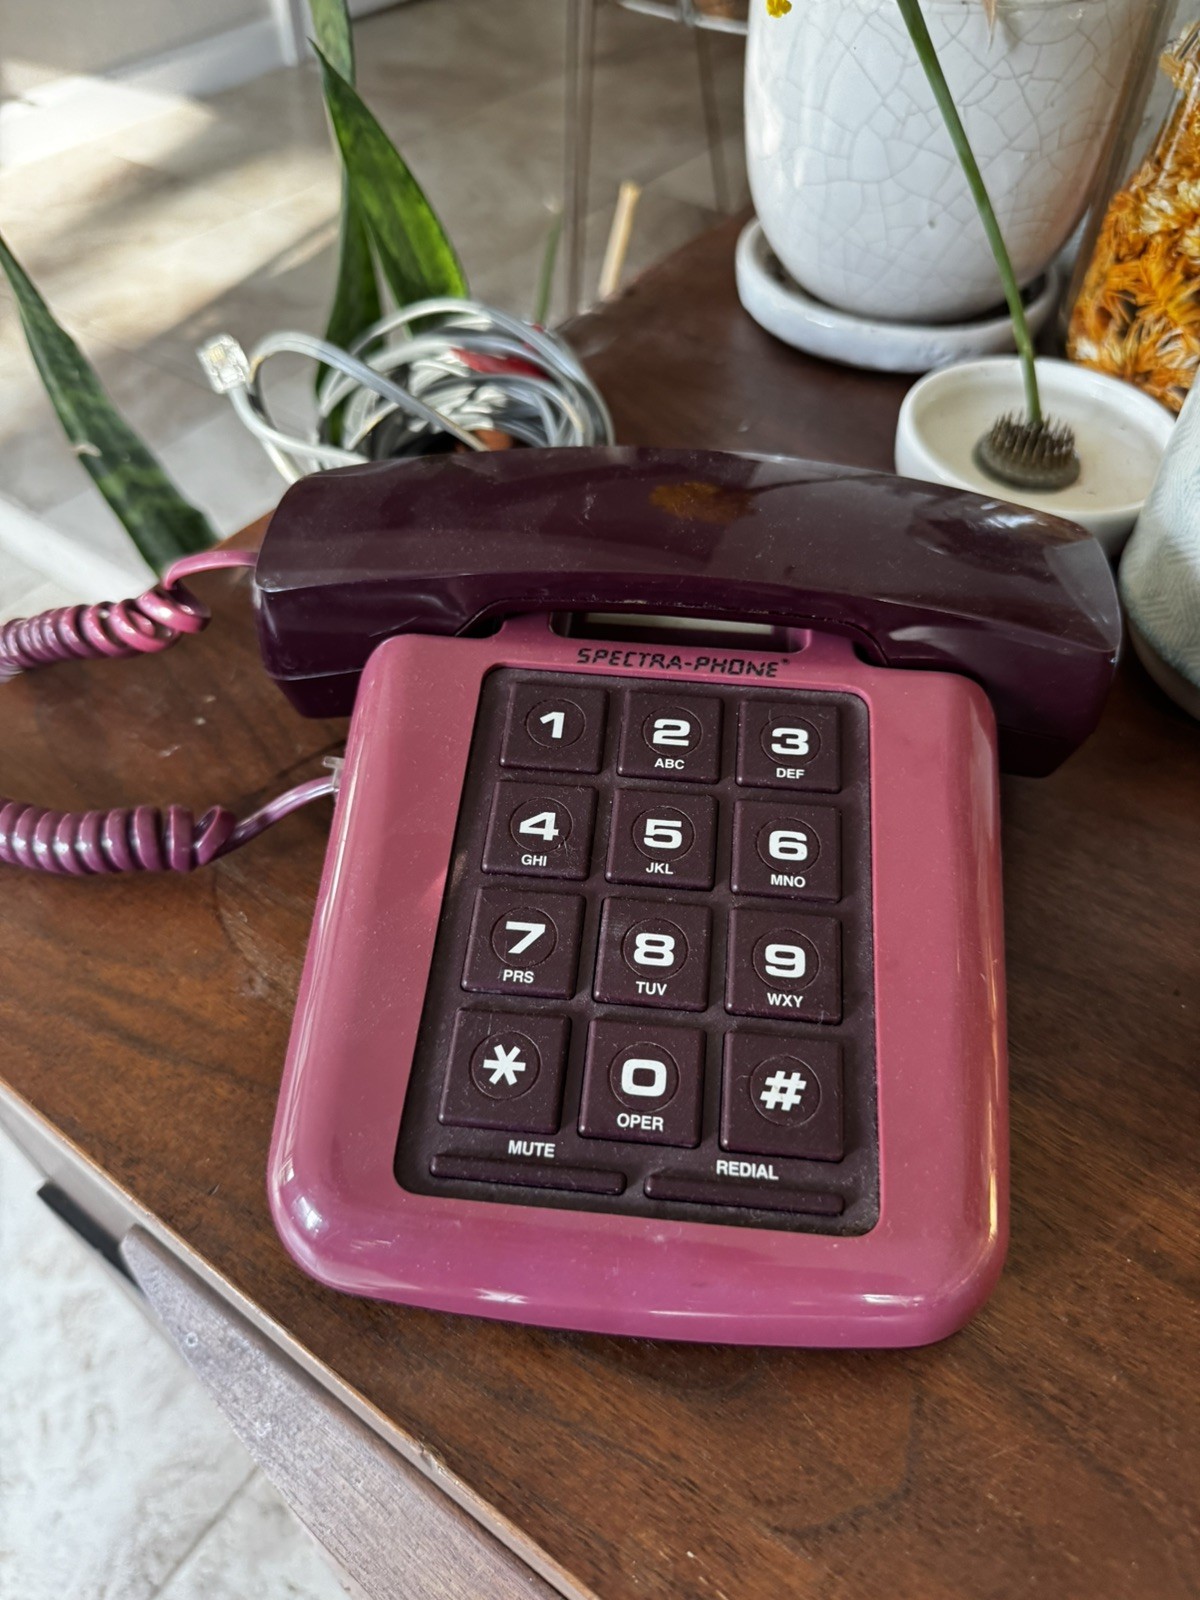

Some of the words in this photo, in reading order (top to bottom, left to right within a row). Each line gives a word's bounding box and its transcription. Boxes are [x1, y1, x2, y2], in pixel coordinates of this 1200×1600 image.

[539, 711, 565, 739] 1
[652, 718, 691, 747] 2
[771, 727, 810, 756] 3
[654, 757, 685, 770] ABC
[775, 767, 805, 780] DEF
[518, 811, 560, 841] 4
[643, 818, 683, 849] 5
[768, 830, 808, 861] 6
[520, 853, 548, 867] GHI
[645, 861, 674, 875] JKL
[770, 873, 806, 889] MNO
[505, 920, 546, 955] 7
[633, 932, 676, 967] 8
[764, 943, 806, 979] 9
[502, 968, 535, 984] PRS
[635, 980, 668, 996] TUV
[766, 992, 804, 1008] WXY
[620, 1058, 668, 1097] 0
[616, 1112, 664, 1132] OPER
[507, 1139, 556, 1159] MUTE
[715, 1159, 780, 1181] REDIAL
